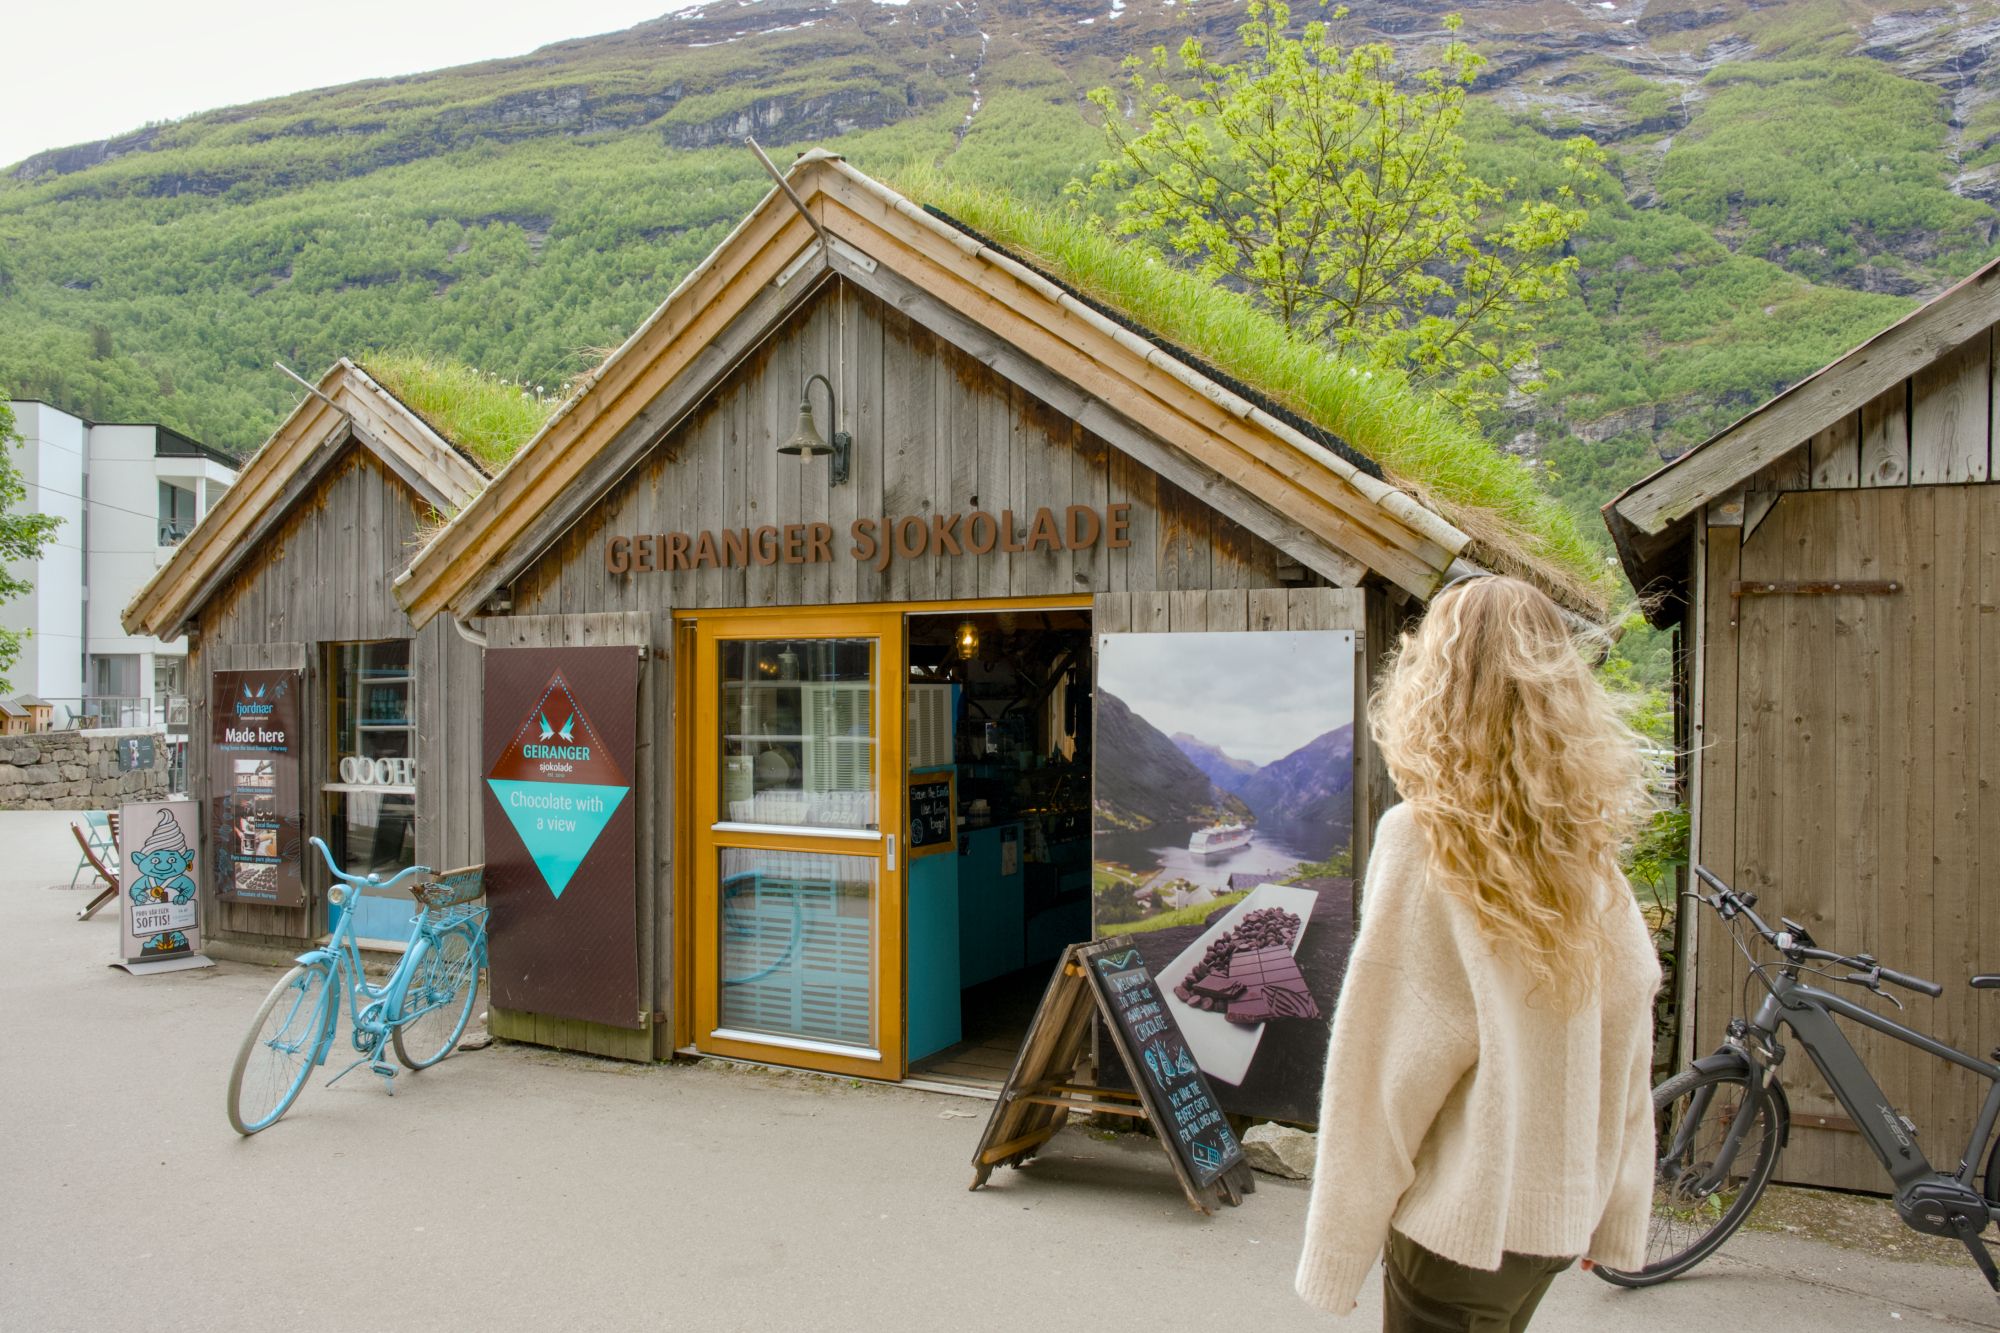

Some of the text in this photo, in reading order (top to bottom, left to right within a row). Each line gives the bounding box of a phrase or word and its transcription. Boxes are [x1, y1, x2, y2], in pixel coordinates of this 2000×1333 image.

[606, 503, 1132, 574] GEIRANGER SJOKOLADE
[236, 701, 273, 717] fjordnær
[225, 727, 285, 743] Made here
[523, 744, 590, 760] GEIRANGER
[539, 762, 573, 773] sjokolade
[510, 791, 604, 812] Chocolate with
[911, 788, 927, 800] Save
[536, 816, 576, 832] a view
[820, 811, 858, 823] OPEN
[136, 914, 170, 928] SOFTIS!
[1135, 1015, 1168, 1042] CHOCOLATE
[1168, 1093, 1181, 1108] WE
[1175, 1103, 1197, 1127] PERFECT
[1876, 1103, 1910, 1146] XEED
